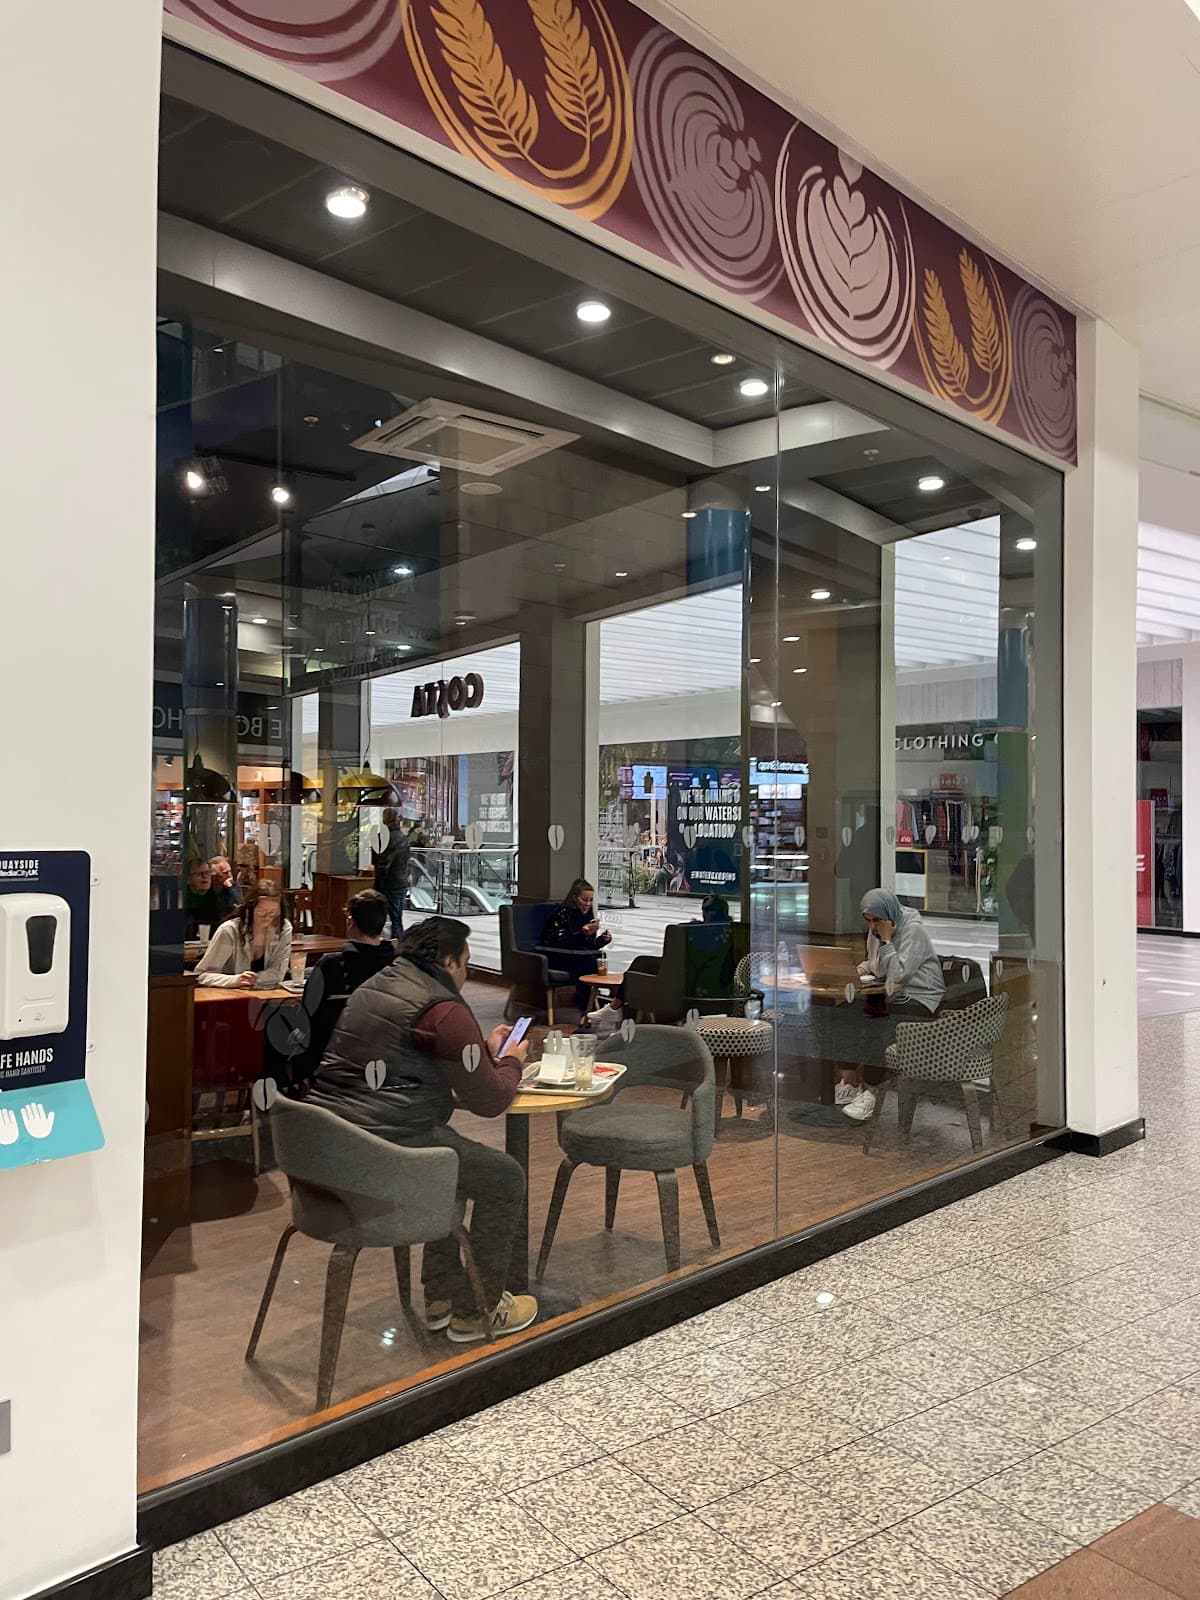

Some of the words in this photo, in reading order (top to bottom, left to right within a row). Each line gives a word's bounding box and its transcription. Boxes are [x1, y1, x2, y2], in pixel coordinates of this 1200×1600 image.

[705, 806, 742, 821] WATERSI
[0, 859, 39, 870] UAYSIDE
[0, 1053, 13, 1069] FE
[16, 1047, 54, 1067] HANDS
